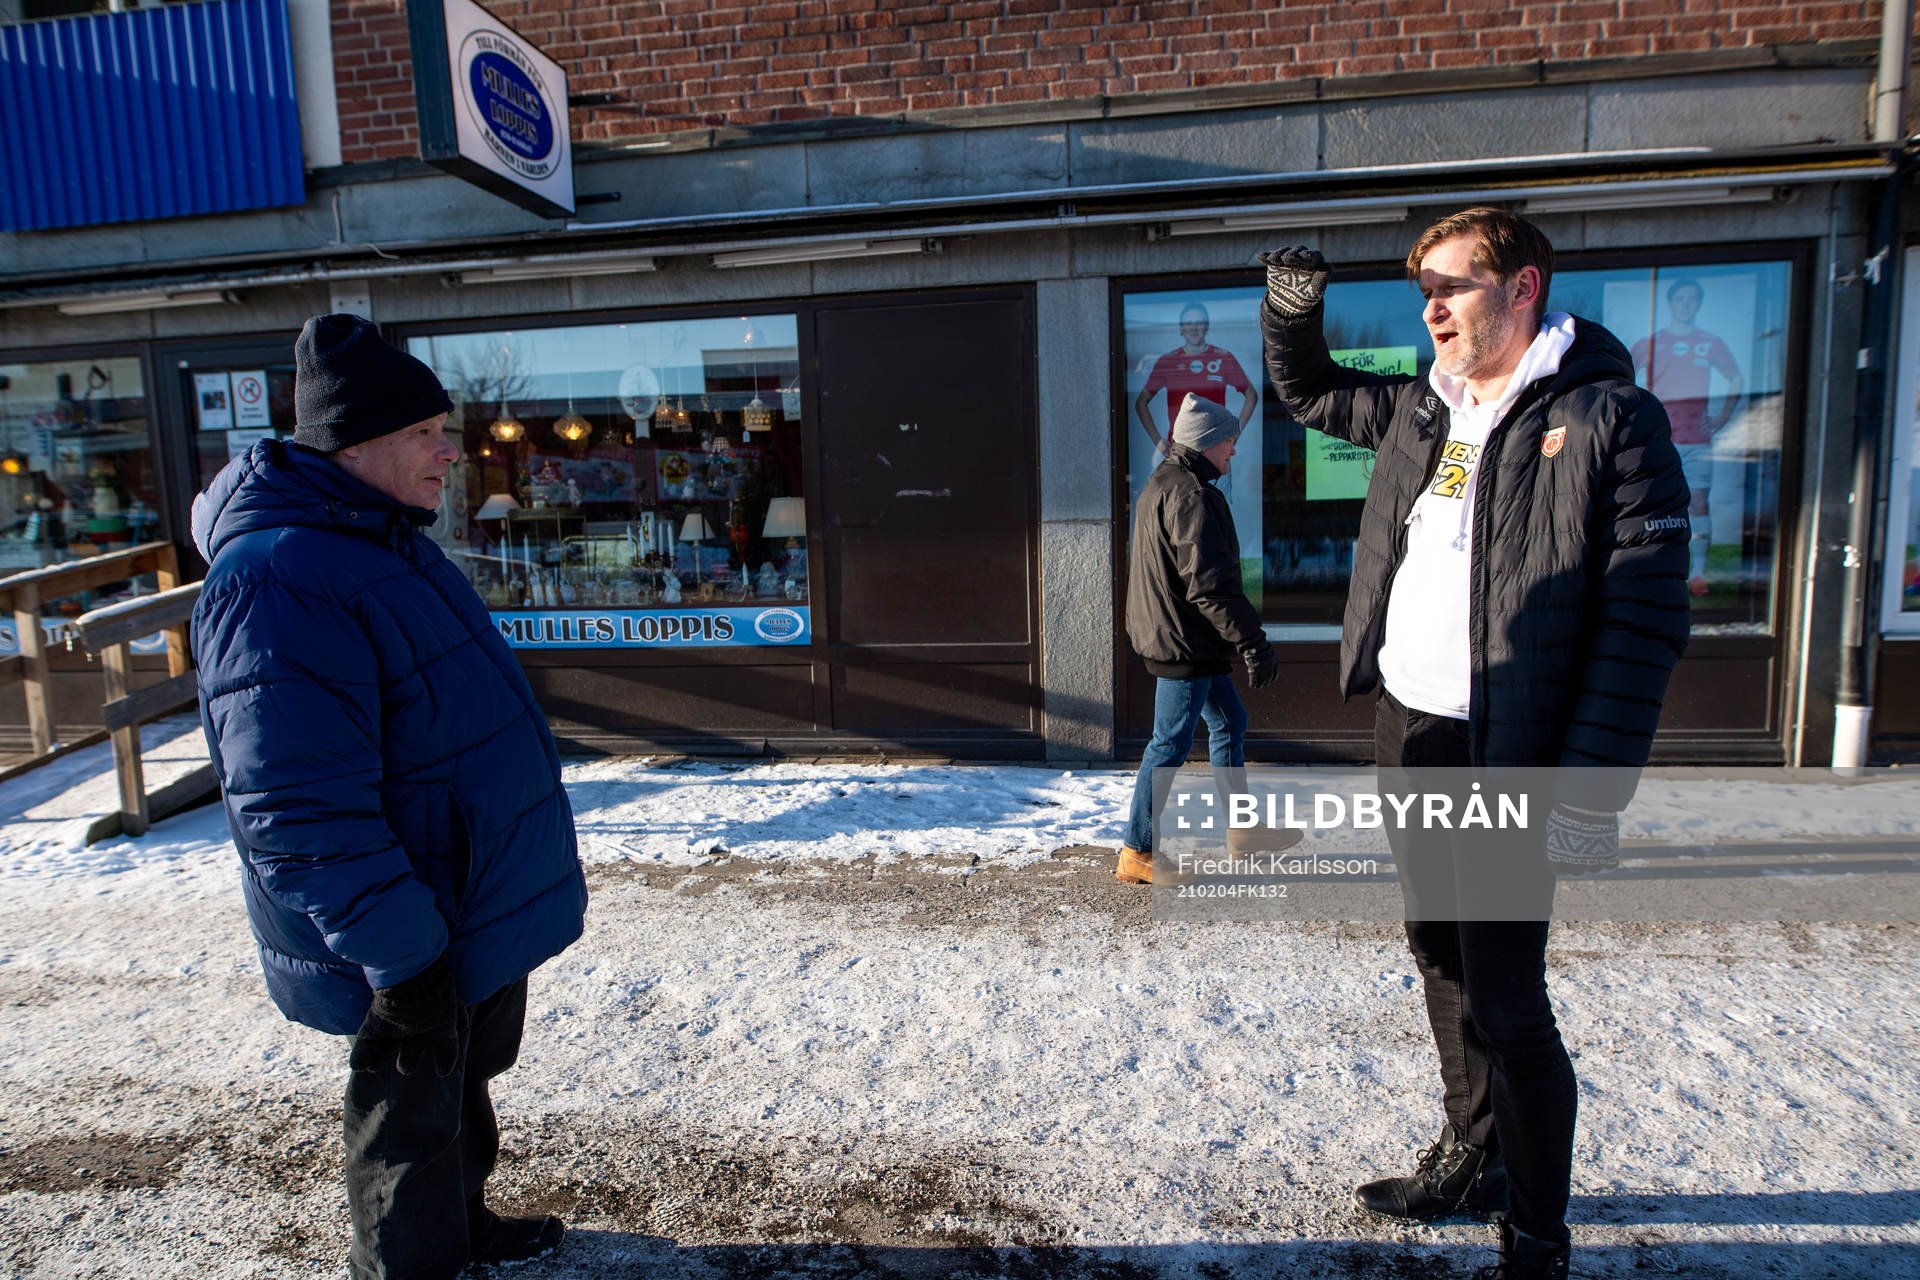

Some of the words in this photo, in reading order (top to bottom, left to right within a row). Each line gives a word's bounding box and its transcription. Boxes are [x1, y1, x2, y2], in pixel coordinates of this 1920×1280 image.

[480, 60, 541, 120] MULLES
[490, 98, 539, 145] LOPPIS
[1351, 352, 1375, 369] FÖR
[1415, 405, 1432, 420] umbro
[1644, 515, 1688, 531] umbro
[499, 616, 615, 643] MULLES
[622, 614, 734, 642] LOPPIS
